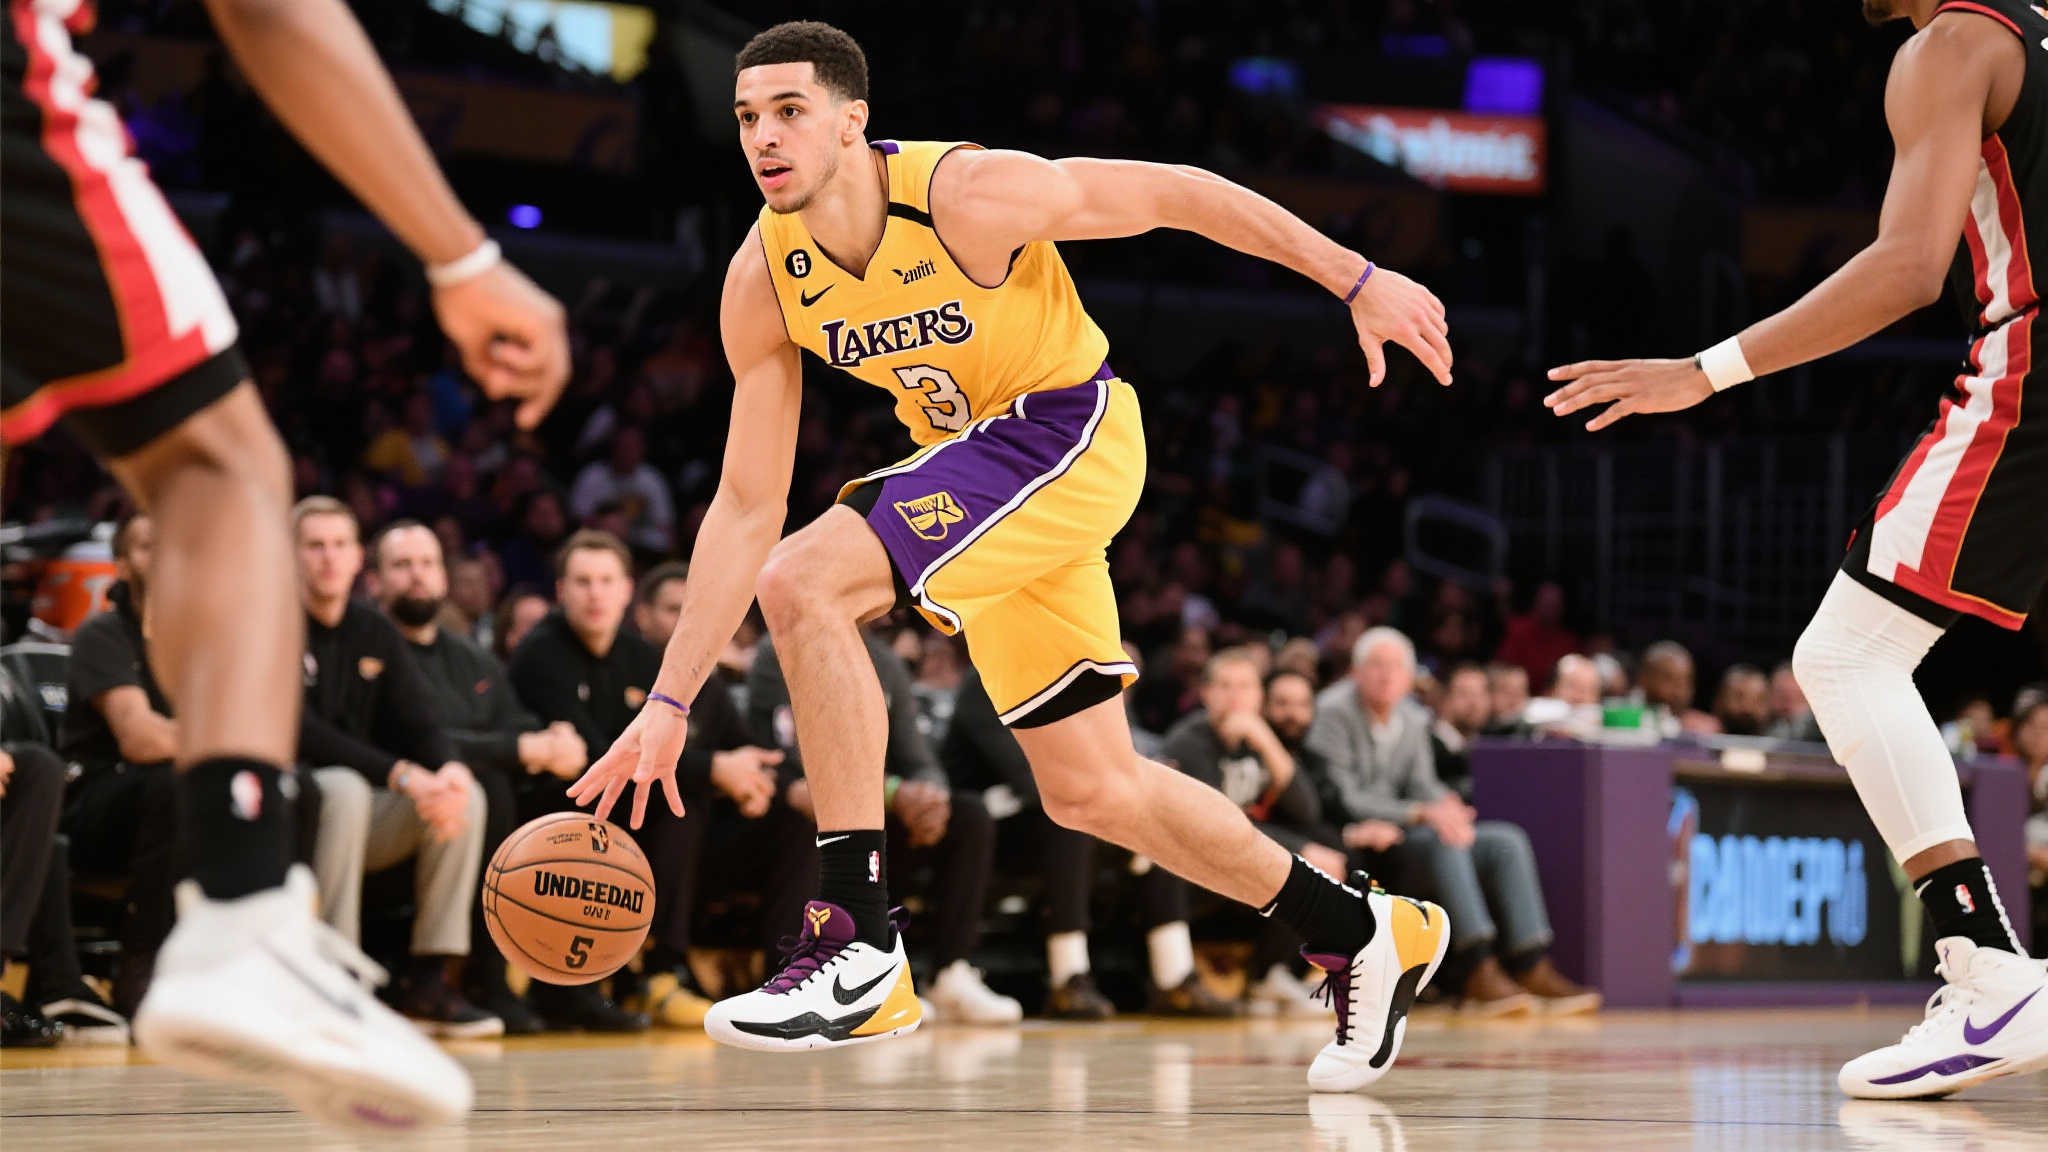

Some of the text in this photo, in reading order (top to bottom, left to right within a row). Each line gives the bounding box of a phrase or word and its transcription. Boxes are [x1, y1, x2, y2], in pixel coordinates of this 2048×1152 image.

[791, 252, 807, 276] 6
[822, 301, 973, 367] LAKERS
[892, 364, 972, 433] 3
[565, 935, 595, 969] 5
